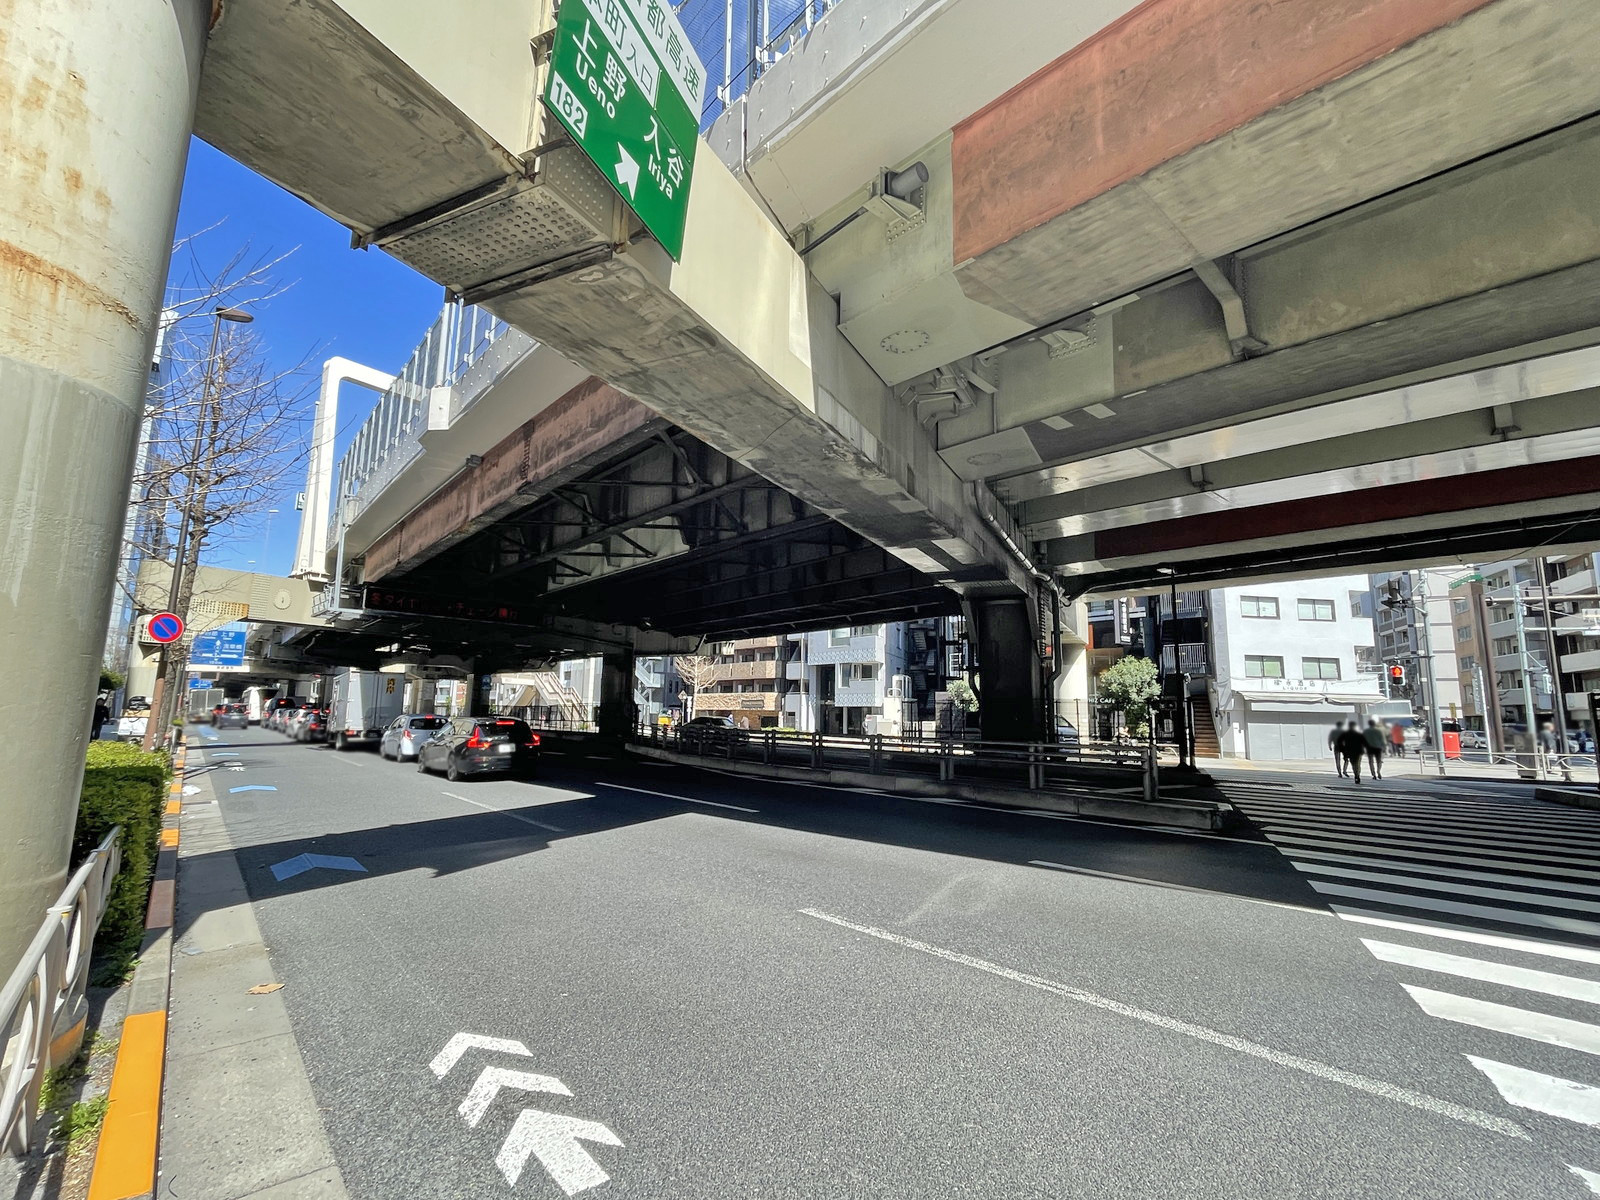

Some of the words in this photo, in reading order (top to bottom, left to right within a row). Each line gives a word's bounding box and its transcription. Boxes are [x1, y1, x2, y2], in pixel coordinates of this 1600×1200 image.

[572, 18, 628, 102] 上野
[575, 53, 616, 119] Ueno
[636, 0, 700, 102] 都高速
[555, 82, 585, 128] 182
[643, 115, 684, 189] 入谷
[648, 154, 673, 200] Iriya
